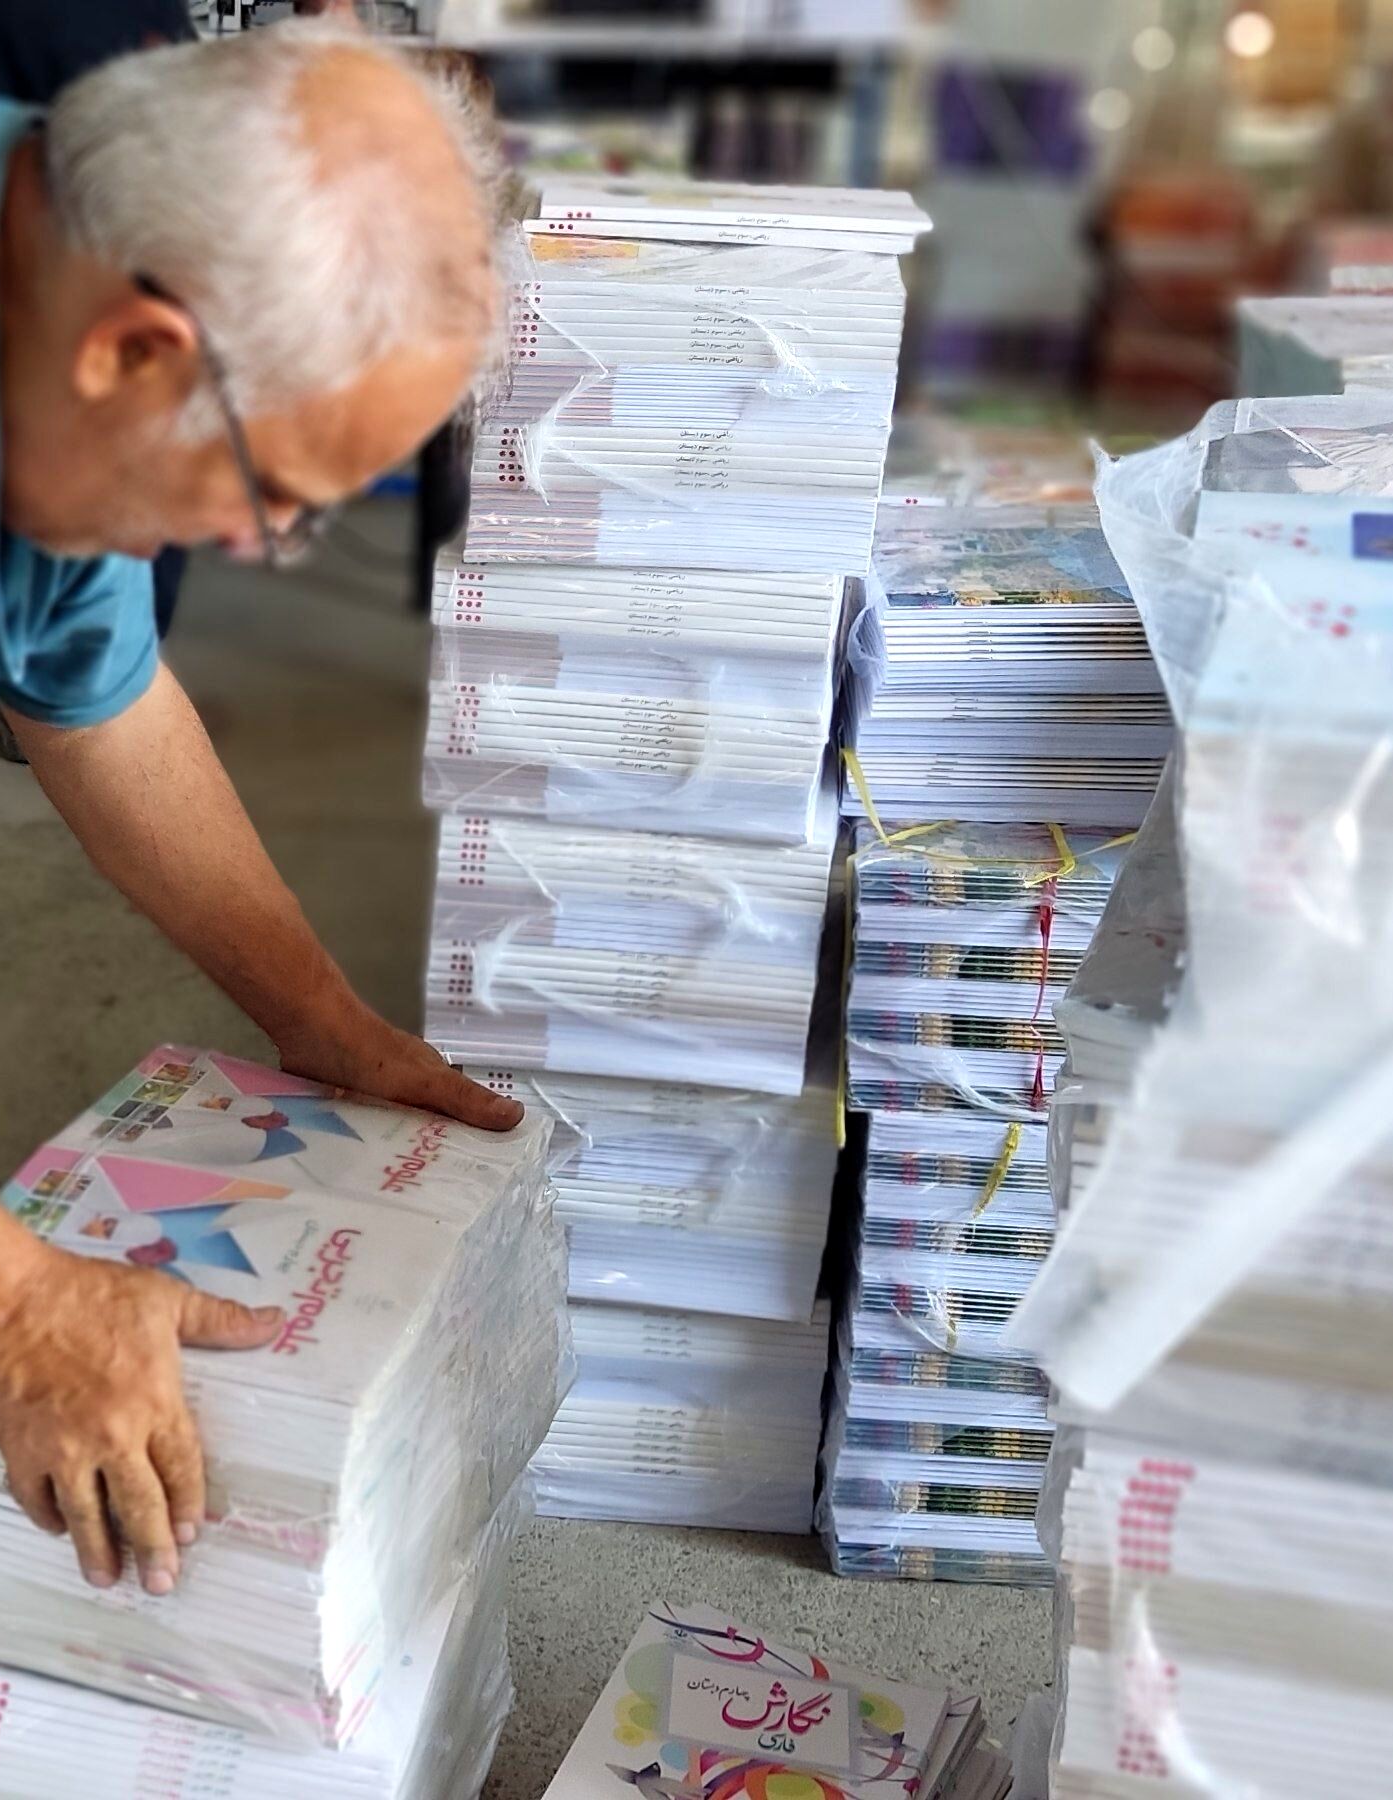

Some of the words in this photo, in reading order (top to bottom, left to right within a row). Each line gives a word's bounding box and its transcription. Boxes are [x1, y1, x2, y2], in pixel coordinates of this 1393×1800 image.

[380, 1153, 426, 1193] علوم
[272, 1290, 326, 1355] علوم
[307, 1228, 362, 1300] تجربی
[686, 1677, 720, 1695] دبستان
[718, 1685, 751, 1701] چهارم
[721, 1681, 834, 1734] نگارش
[757, 1733, 796, 1753] فارسی
